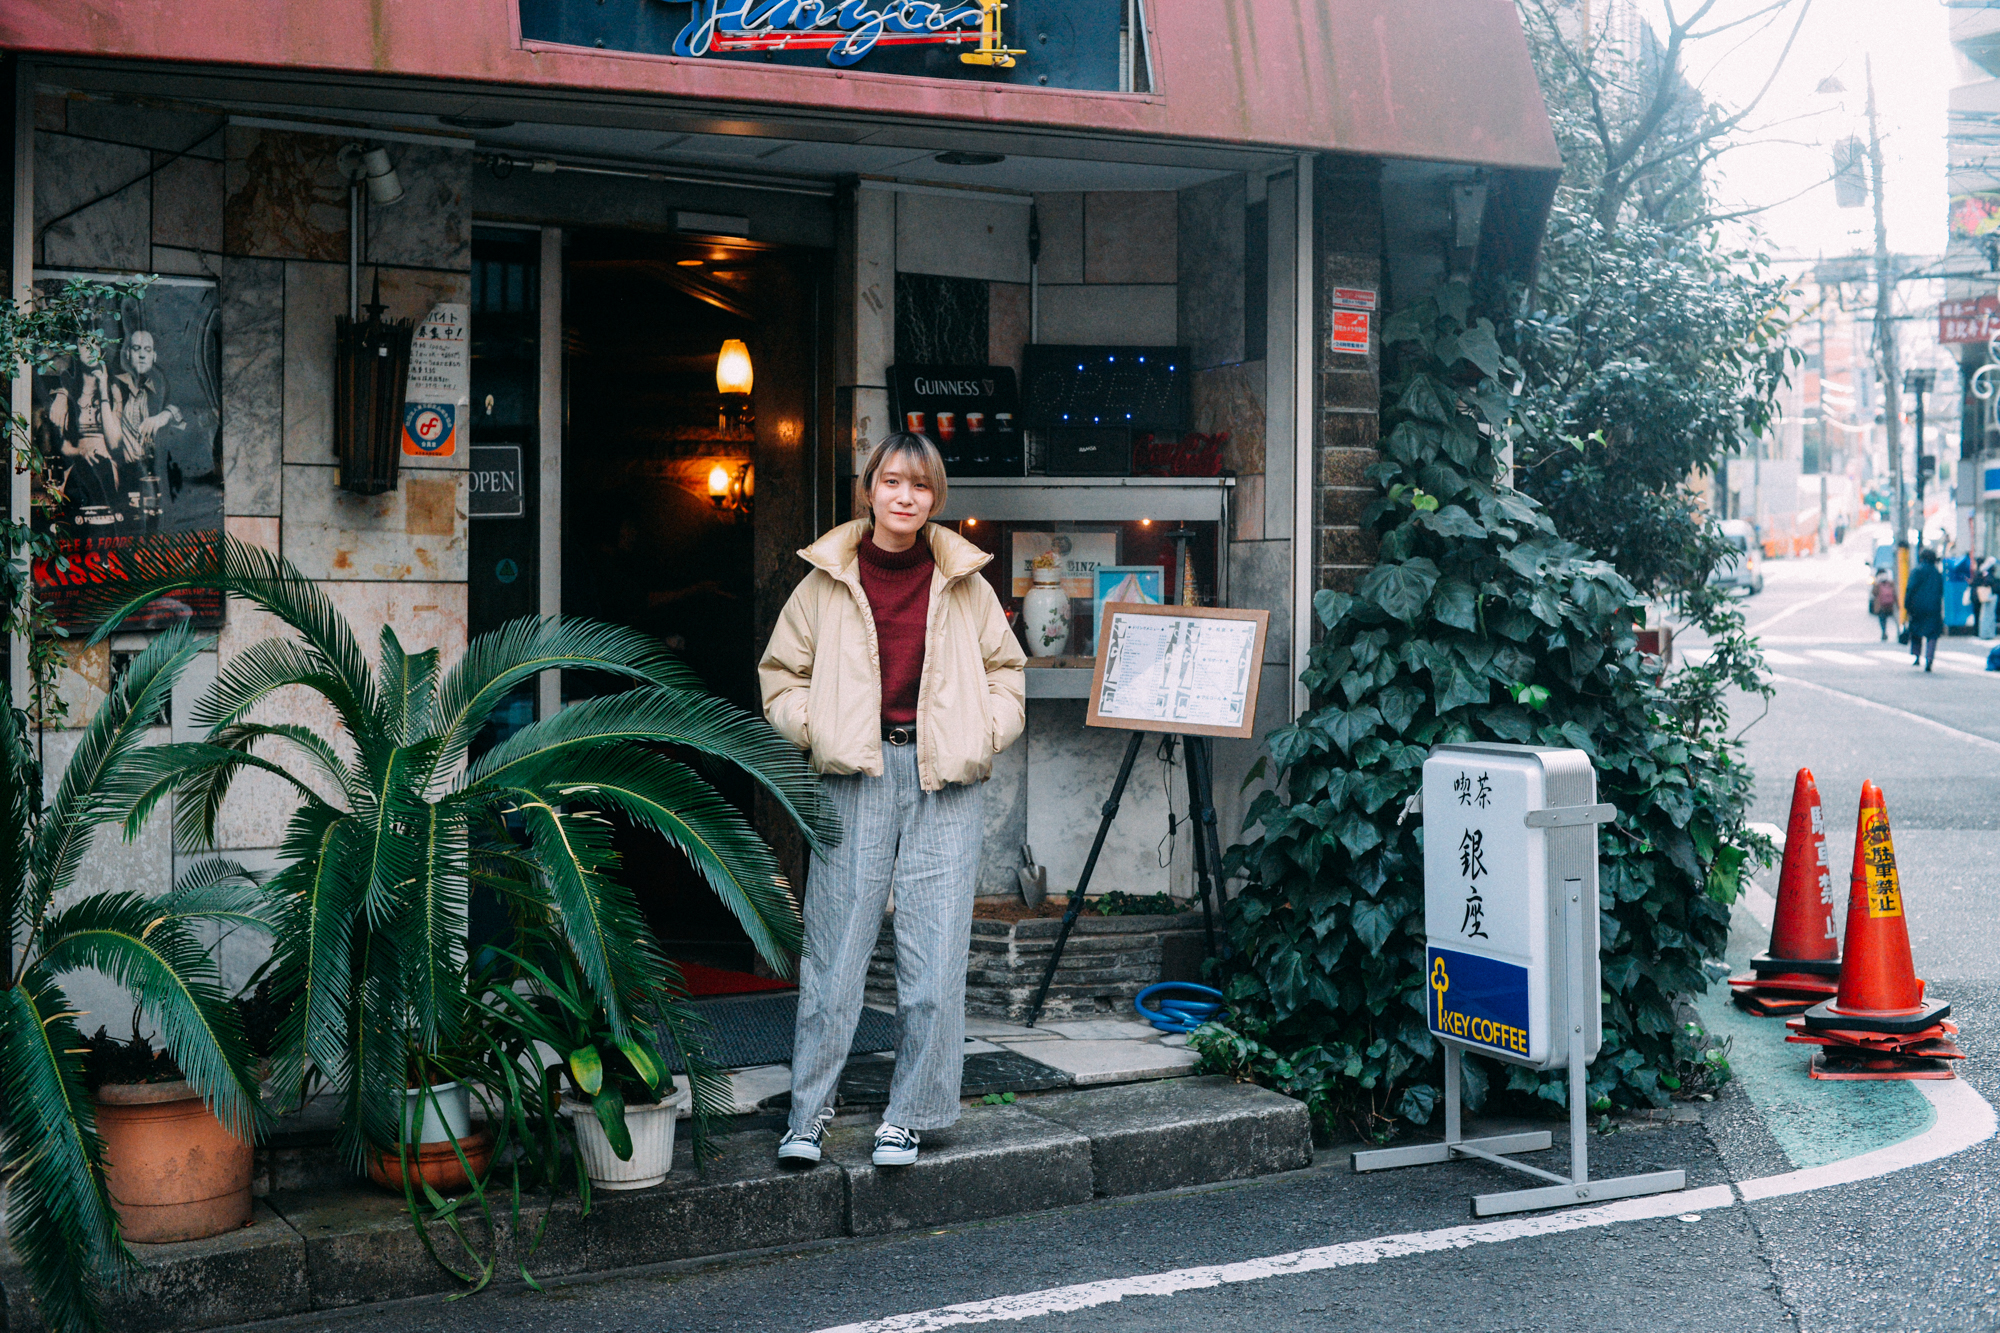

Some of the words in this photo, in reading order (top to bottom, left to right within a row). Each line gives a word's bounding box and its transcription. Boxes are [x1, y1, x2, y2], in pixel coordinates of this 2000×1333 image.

[914, 377, 979, 395] GUINNESS
[469, 471, 515, 493] OPEN
[33, 551, 128, 587] KISSA
[1453, 771, 1493, 810] 喫茶
[1458, 827, 1488, 940] 銀座
[1873, 847, 1896, 911] 駐車禁止
[1443, 1011, 1471, 1037] KEY
[1471, 1017, 1528, 1054] COFFEE
